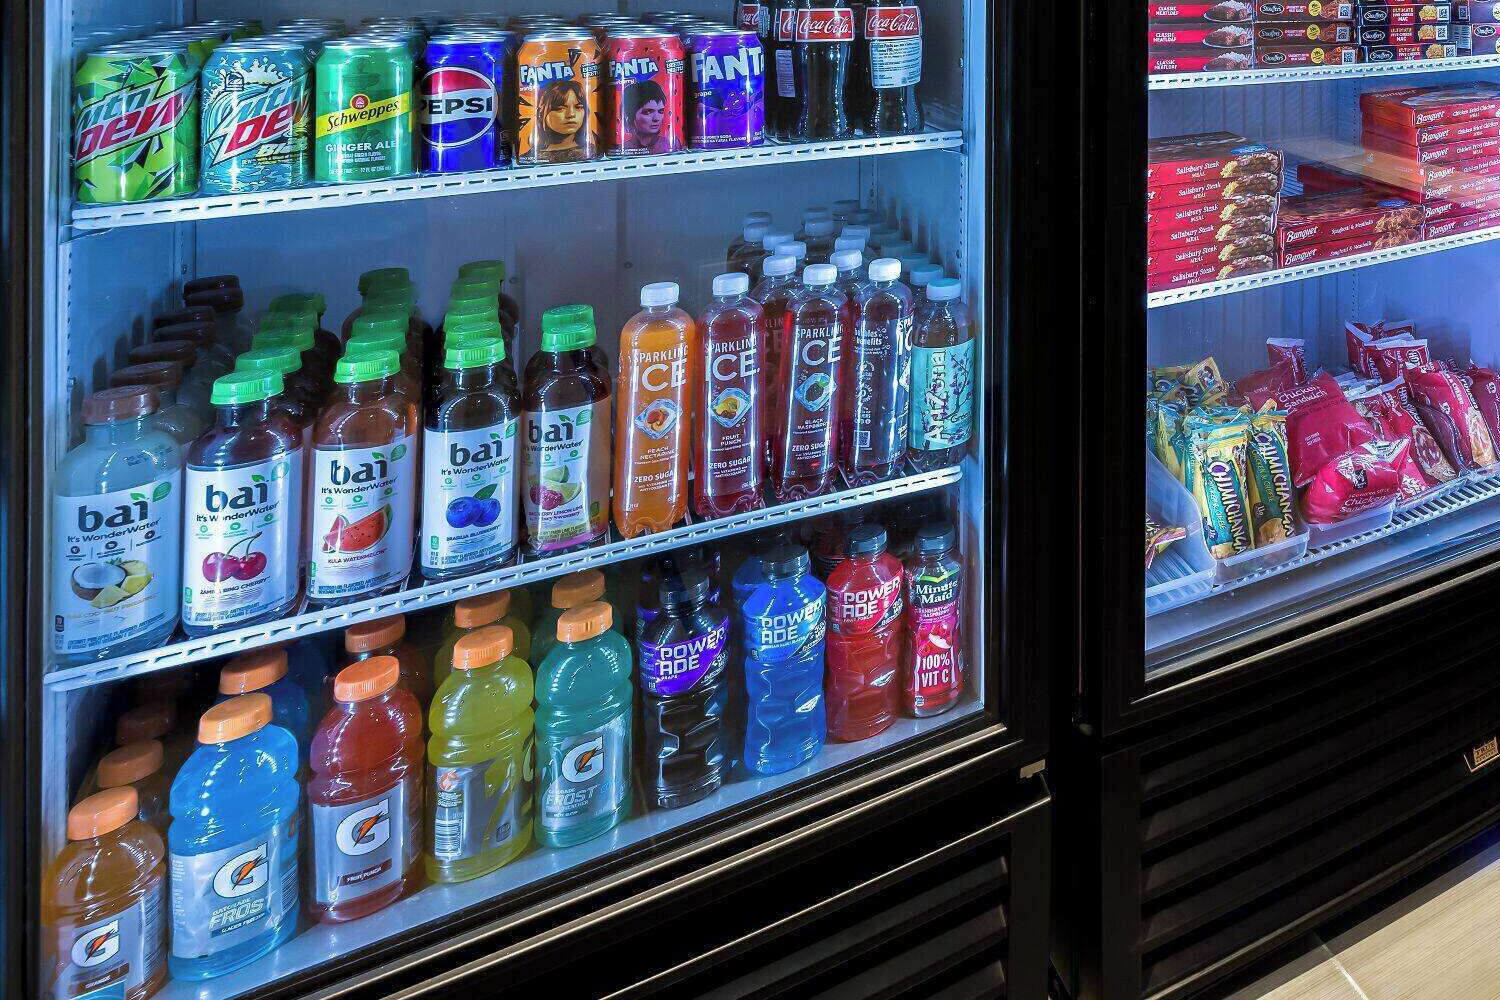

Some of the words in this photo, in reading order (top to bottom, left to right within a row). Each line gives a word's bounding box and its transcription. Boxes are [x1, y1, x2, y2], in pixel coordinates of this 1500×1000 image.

[800, 15, 852, 34] Coca-Cola
[867, 14, 918, 33] Coca-Cola
[519, 62, 574, 83] FANTA
[609, 58, 658, 79] FANTA
[327, 100, 399, 132] Schweppes
[326, 142, 371, 151] GINGER
[375, 140, 397, 150] ALE
[633, 359, 687, 392] ICE
[706, 350, 757, 382] ICE
[1285, 389, 1328, 410] Sandwich
[528, 418, 575, 443] bai
[450, 438, 504, 467] bai
[453, 455, 512, 475] WonderWater
[709, 459, 727, 469] ZERO
[333, 477, 398, 494] WonderWater
[634, 474, 654, 484] ZERO
[844, 576, 901, 605] POWER
[916, 580, 958, 595] Minute
[921, 592, 954, 605] Maid
[761, 599, 822, 631] POWER
[842, 600, 879, 618] ADE
[761, 625, 798, 644] ADE
[921, 652, 951, 670] 100%
[921, 670, 940, 687] VIT
[943, 670, 950, 684] C
[336, 797, 391, 856] G
[213, 842, 269, 898] G
